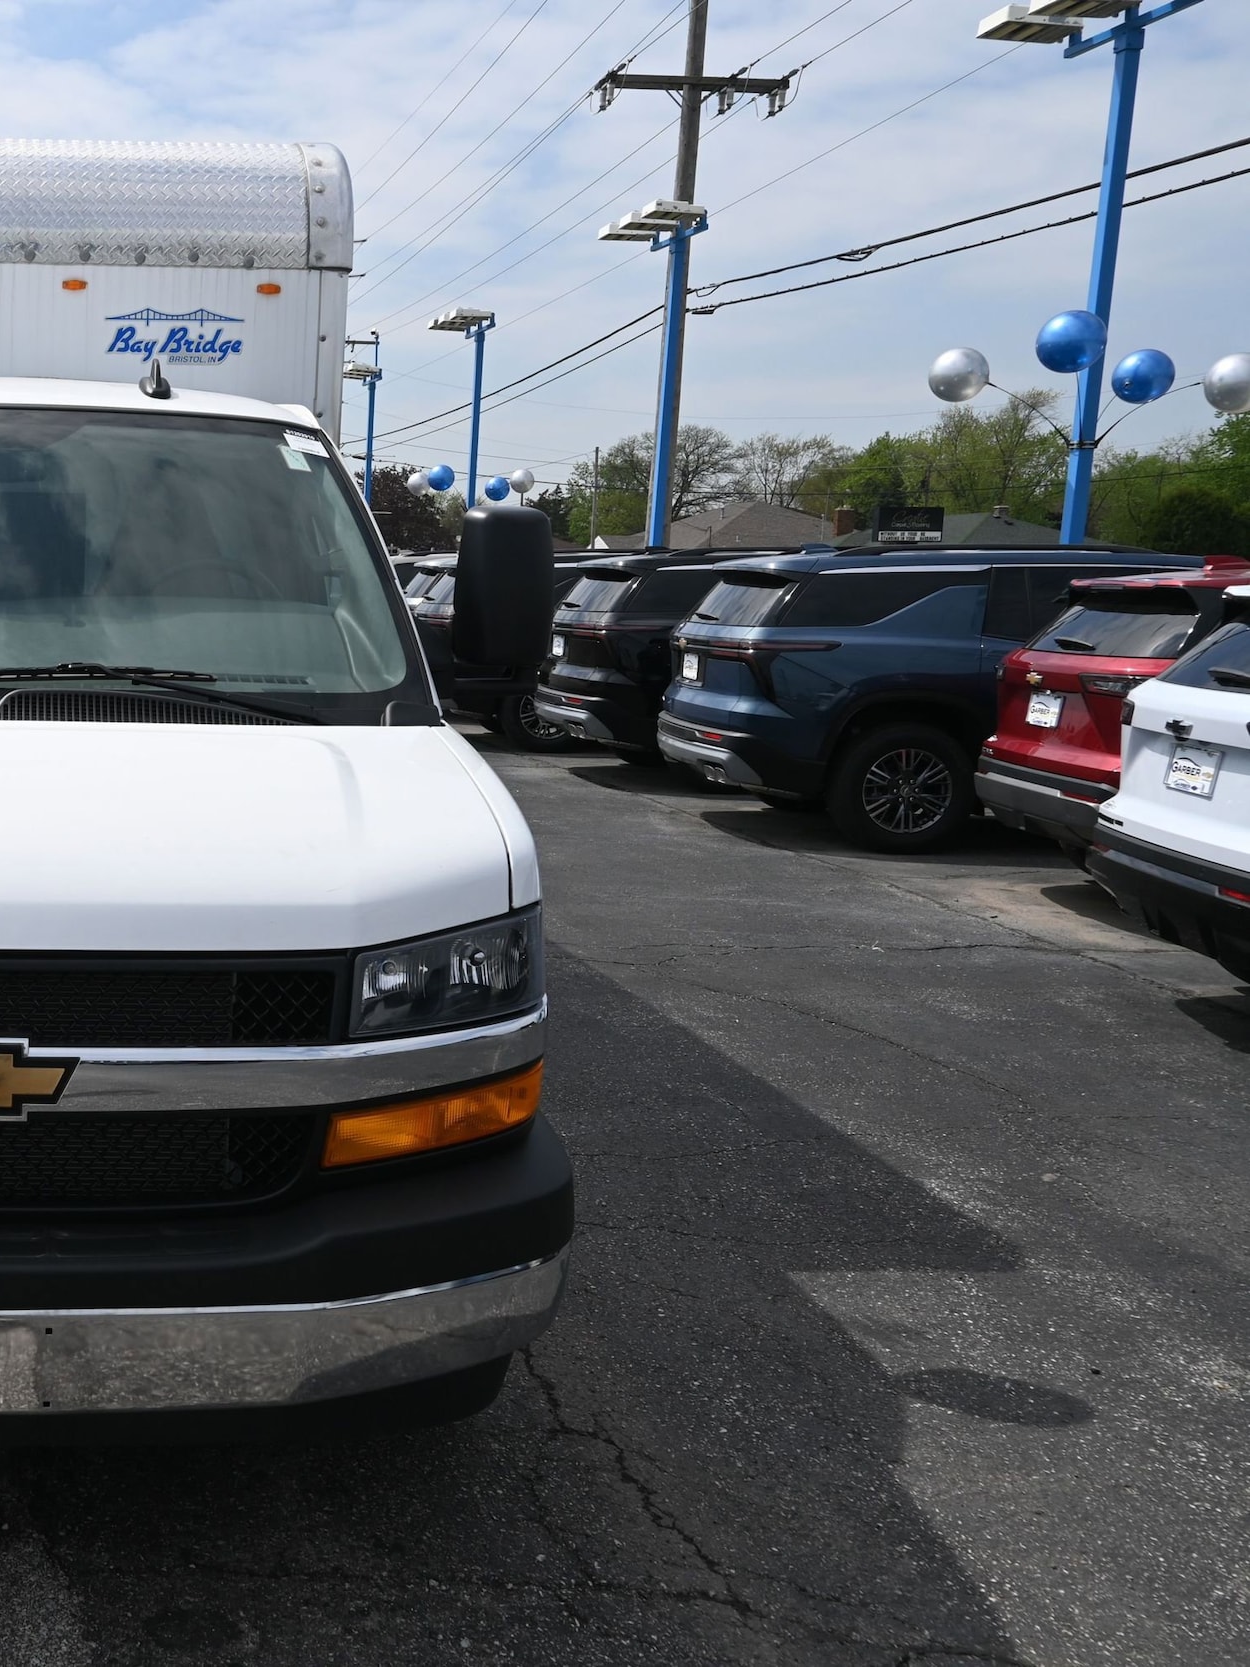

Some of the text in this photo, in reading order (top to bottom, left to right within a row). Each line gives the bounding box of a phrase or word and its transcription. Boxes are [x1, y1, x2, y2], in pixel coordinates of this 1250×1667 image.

[107, 326, 242, 362] Bay Bridge
[207, 355, 217, 363] IN
[1172, 761, 1201, 777] GARBER
